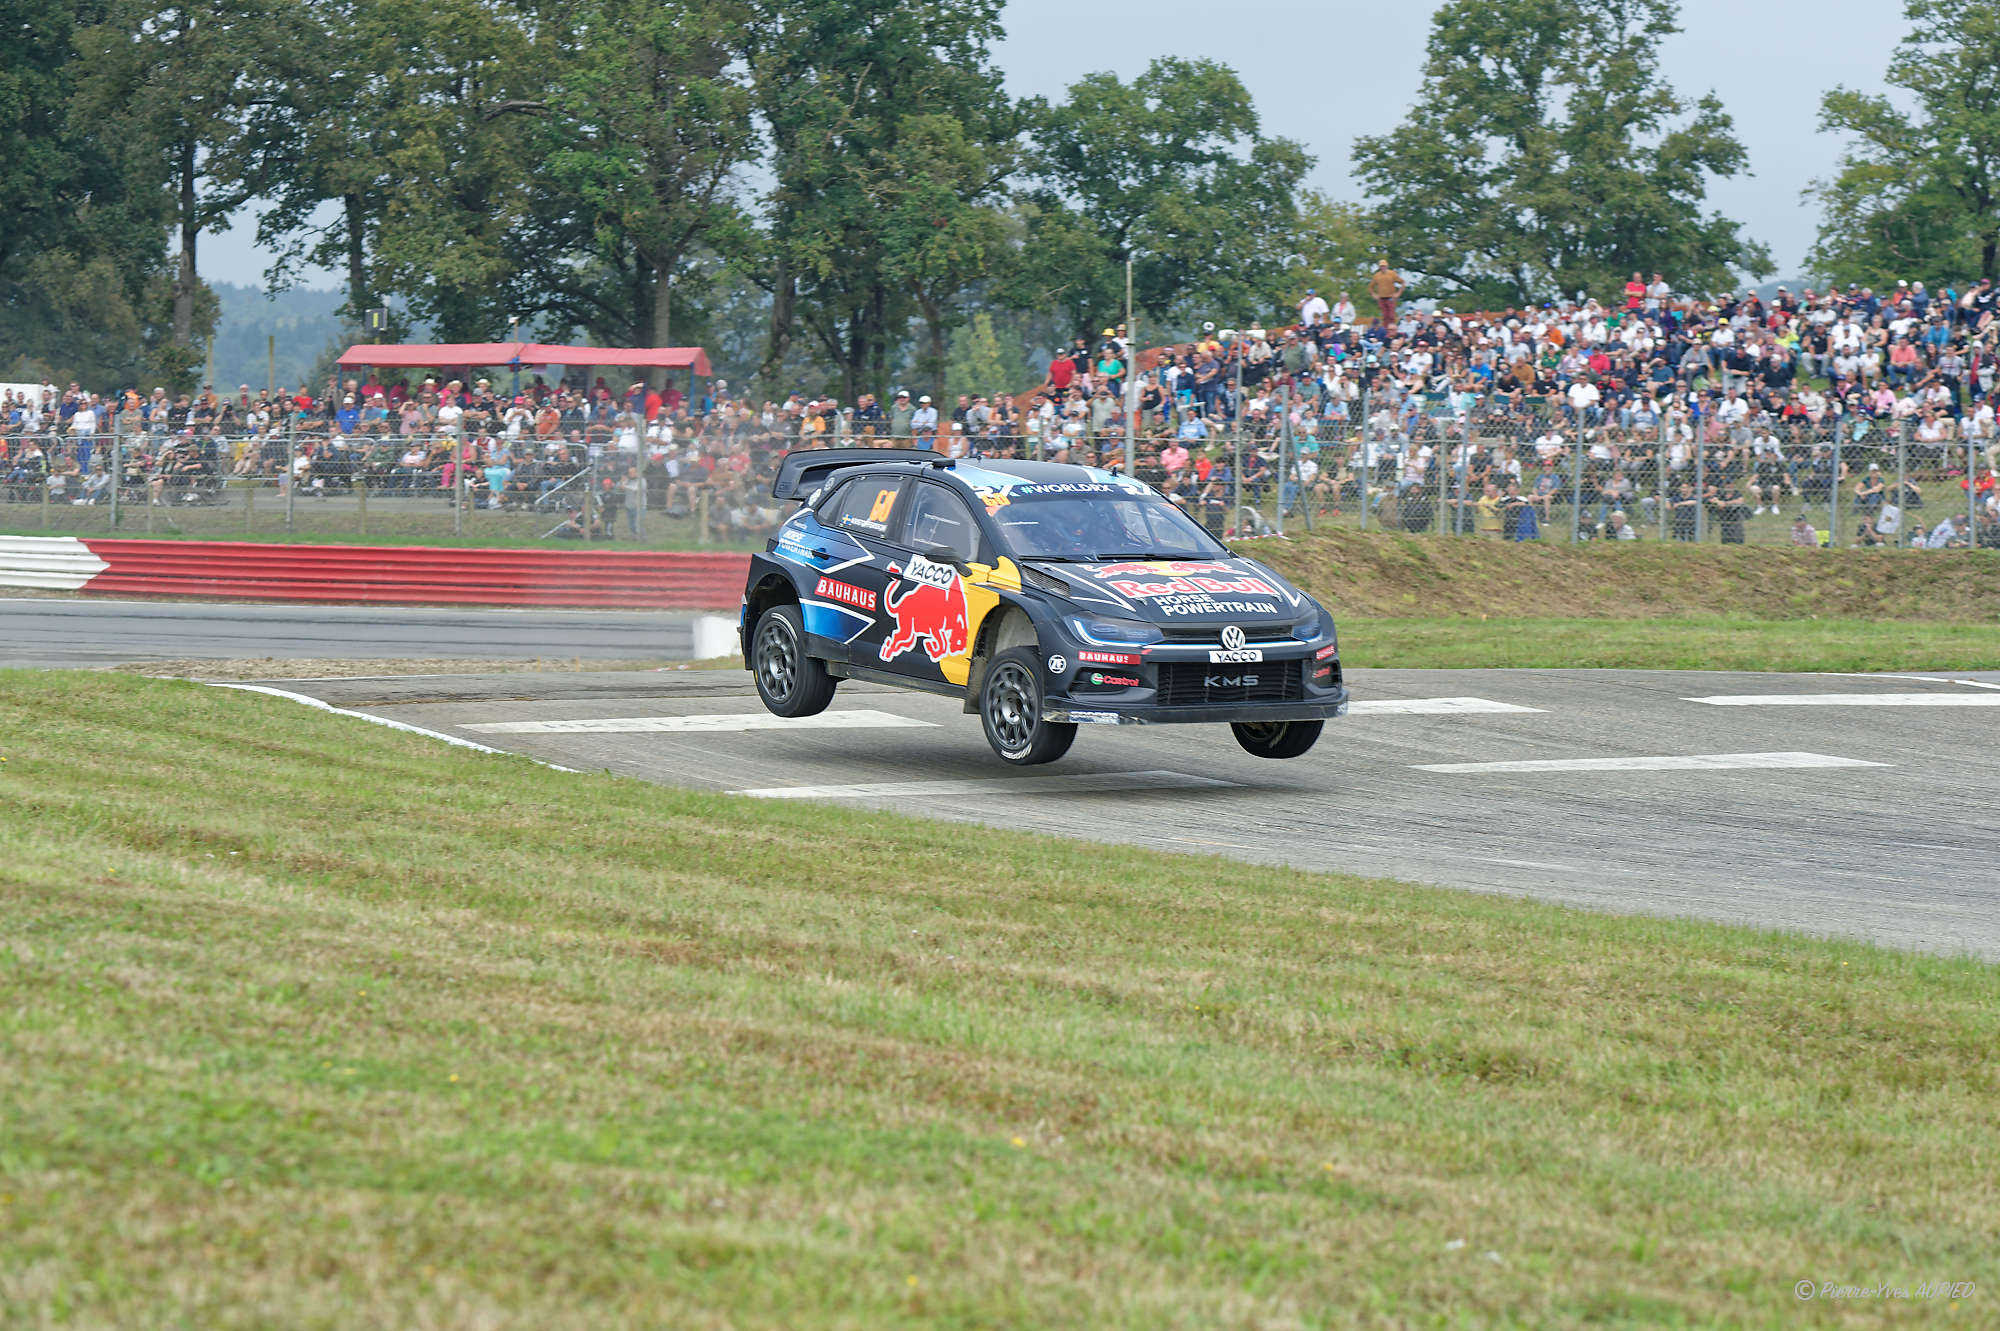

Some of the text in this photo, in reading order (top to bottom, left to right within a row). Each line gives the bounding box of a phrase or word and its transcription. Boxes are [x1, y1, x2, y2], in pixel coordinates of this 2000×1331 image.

[1021, 483, 1114, 495] #WORLDRX
[911, 561, 953, 585] YACCO
[1109, 576, 1280, 598] Red Bull
[817, 579, 876, 609] BAUHAUS
[1152, 594, 1216, 606] HORSE
[1160, 602, 1278, 617] POWERTRAIN
[1216, 651, 1257, 663] YACCO
[1102, 675, 1140, 687] Castrol
[1203, 675, 1260, 687] KMS
